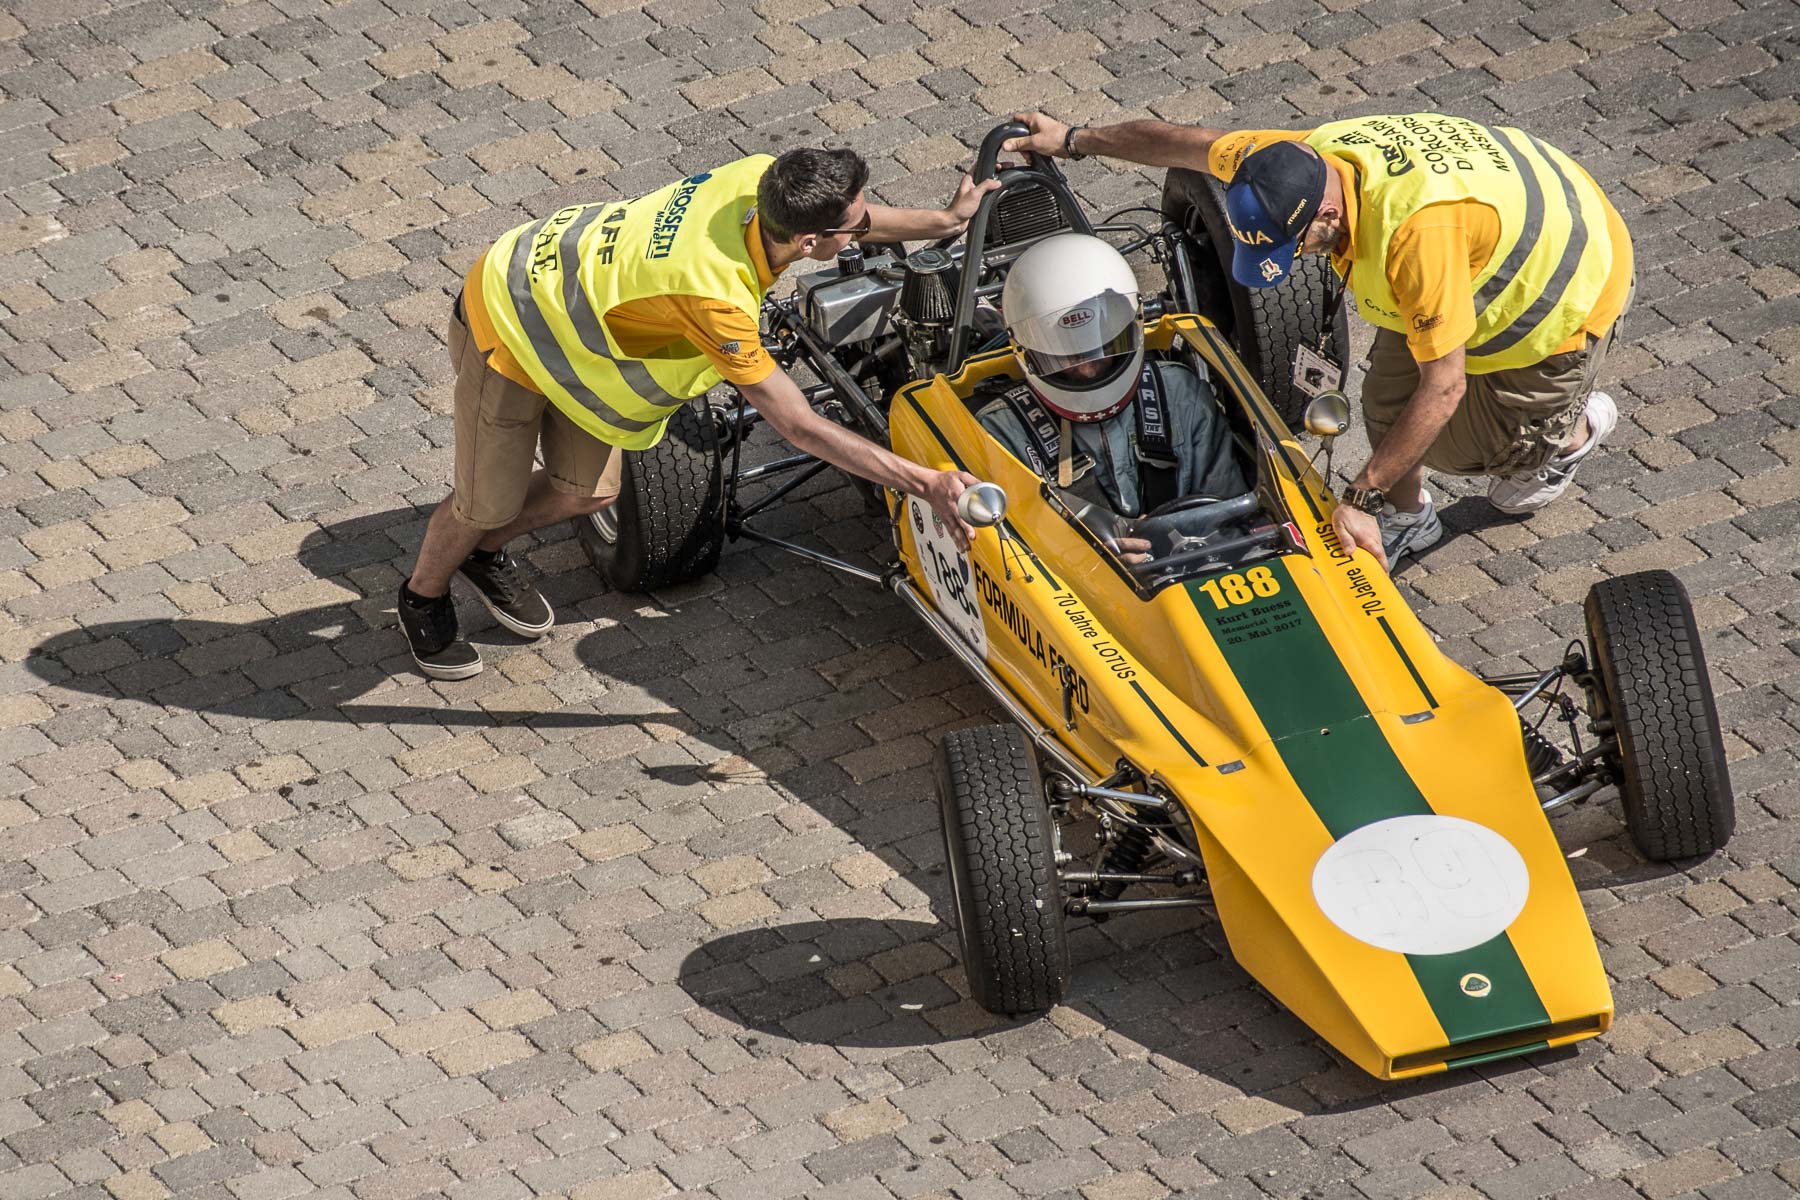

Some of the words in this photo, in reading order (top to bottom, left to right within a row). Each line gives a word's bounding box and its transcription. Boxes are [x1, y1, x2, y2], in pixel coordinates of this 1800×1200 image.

[652, 210, 664, 250] Market
[660, 184, 701, 260] ROSSETTI
[1061, 310, 1092, 327] BELL
[1198, 565, 1281, 610] 188
[1346, 566, 1377, 599] Jahre
[973, 560, 1048, 669] FORMULA
[1215, 610, 1248, 626] Kurt
[1249, 600, 1292, 617] Buess
[1221, 618, 1268, 635] Memorial
[1273, 610, 1298, 622] Race
[1362, 599, 1386, 617] 70
[1053, 592, 1069, 608] 70
[1065, 607, 1098, 639] Jahre
[1092, 640, 1137, 681] LOTUS
[1248, 629, 1272, 641] Mai
[1273, 619, 1303, 635] 2017
